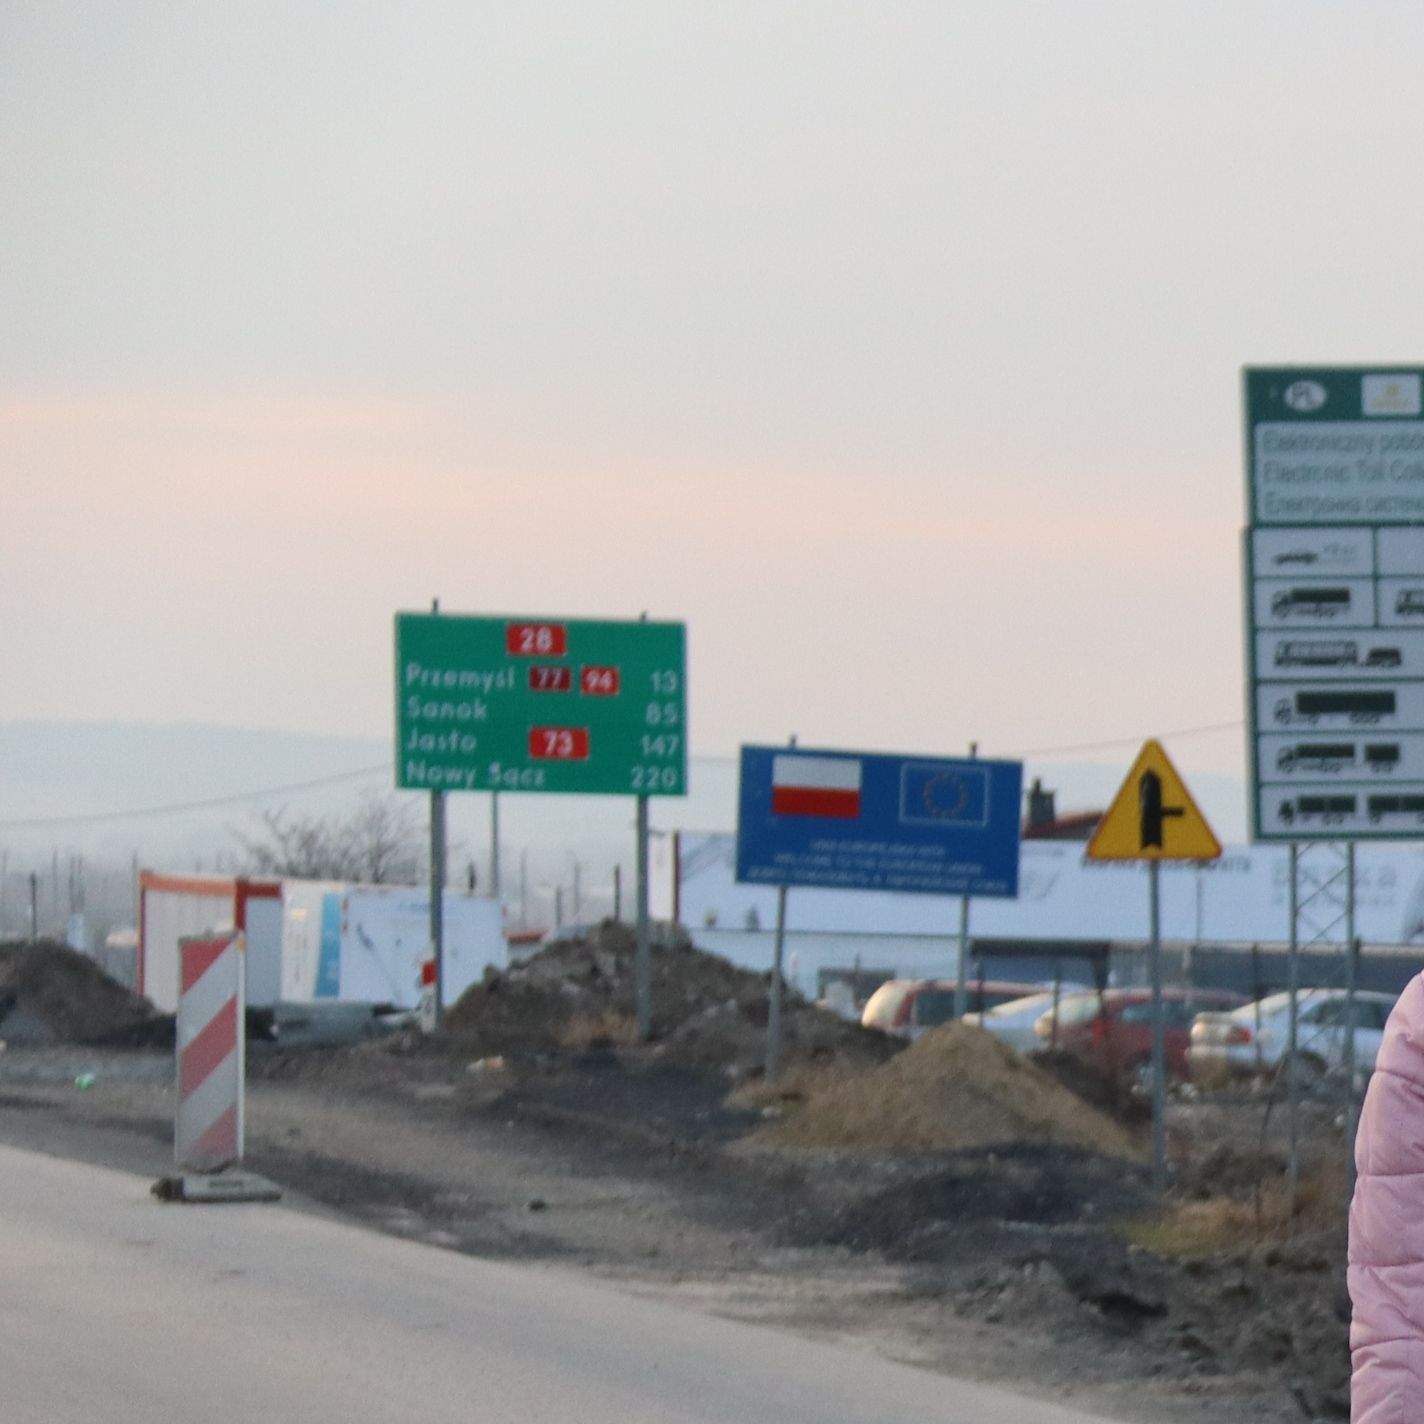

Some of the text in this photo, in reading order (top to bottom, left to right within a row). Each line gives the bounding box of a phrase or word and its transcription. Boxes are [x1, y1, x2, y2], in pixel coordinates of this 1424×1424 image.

[520, 627, 553, 651] 28
[537, 668, 563, 688] 77
[586, 671, 613, 689] 94
[652, 670, 678, 693] 13
[407, 697, 487, 720] Sanok
[544, 730, 574, 758] 73
[641, 734, 681, 757] 147
[406, 761, 477, 789] Nowy
[631, 766, 678, 790] 220
